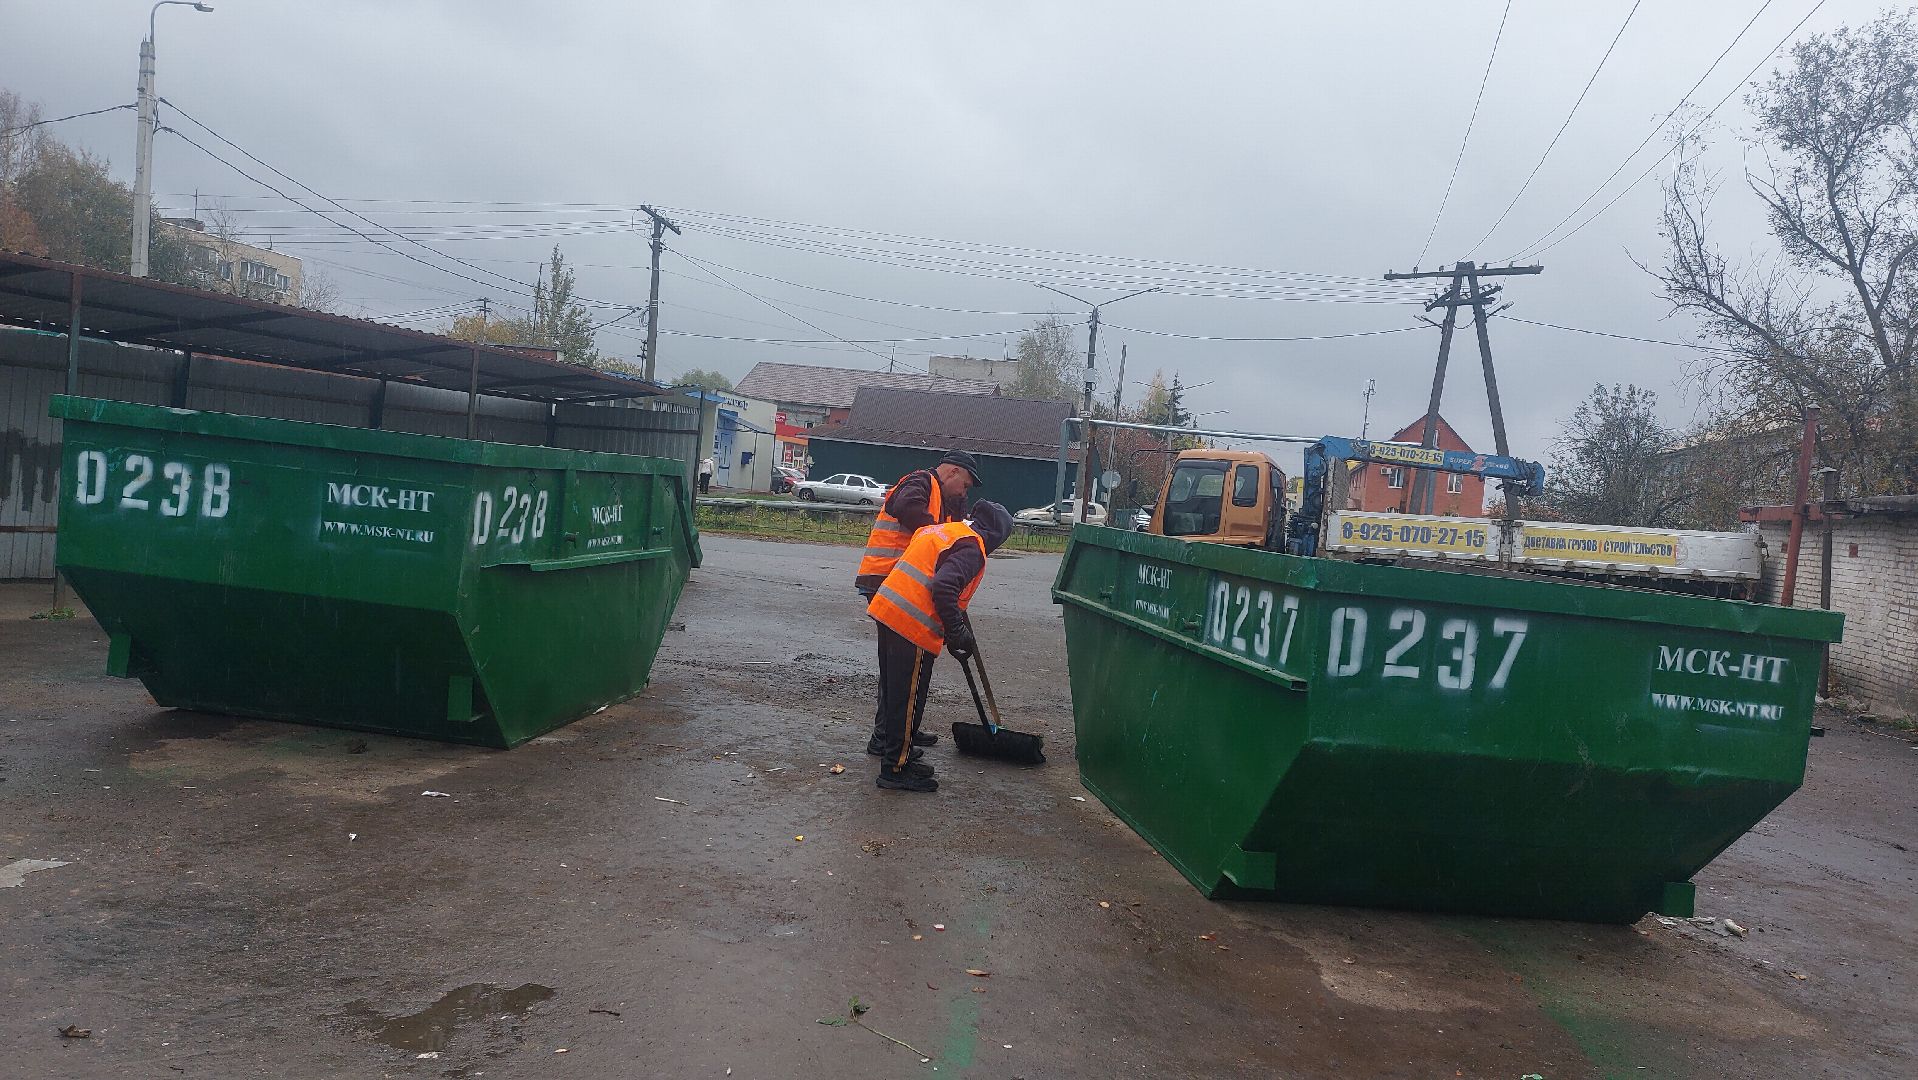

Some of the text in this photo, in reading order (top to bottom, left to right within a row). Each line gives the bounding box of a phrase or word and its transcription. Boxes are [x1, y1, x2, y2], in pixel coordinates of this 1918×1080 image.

[1370, 444, 1442, 463] 8-925-070-27-15
[77, 450, 231, 518] 0238
[327, 482, 435, 513] МСК-НТ
[472, 486, 548, 546] 0238
[323, 521, 435, 543] WWW.MSK-NT.RU
[1342, 521, 1486, 548] 8-925-070-27-15
[1524, 536, 1673, 557] ДОСТАВКА ГРУЗОВ СТРОИТЕЛЬСТВО
[1137, 563, 1173, 589] МСК-НТ
[1212, 580, 1300, 665] 0237
[1326, 607, 1529, 690] 0237
[1656, 645, 1790, 684] МСК-НТ
